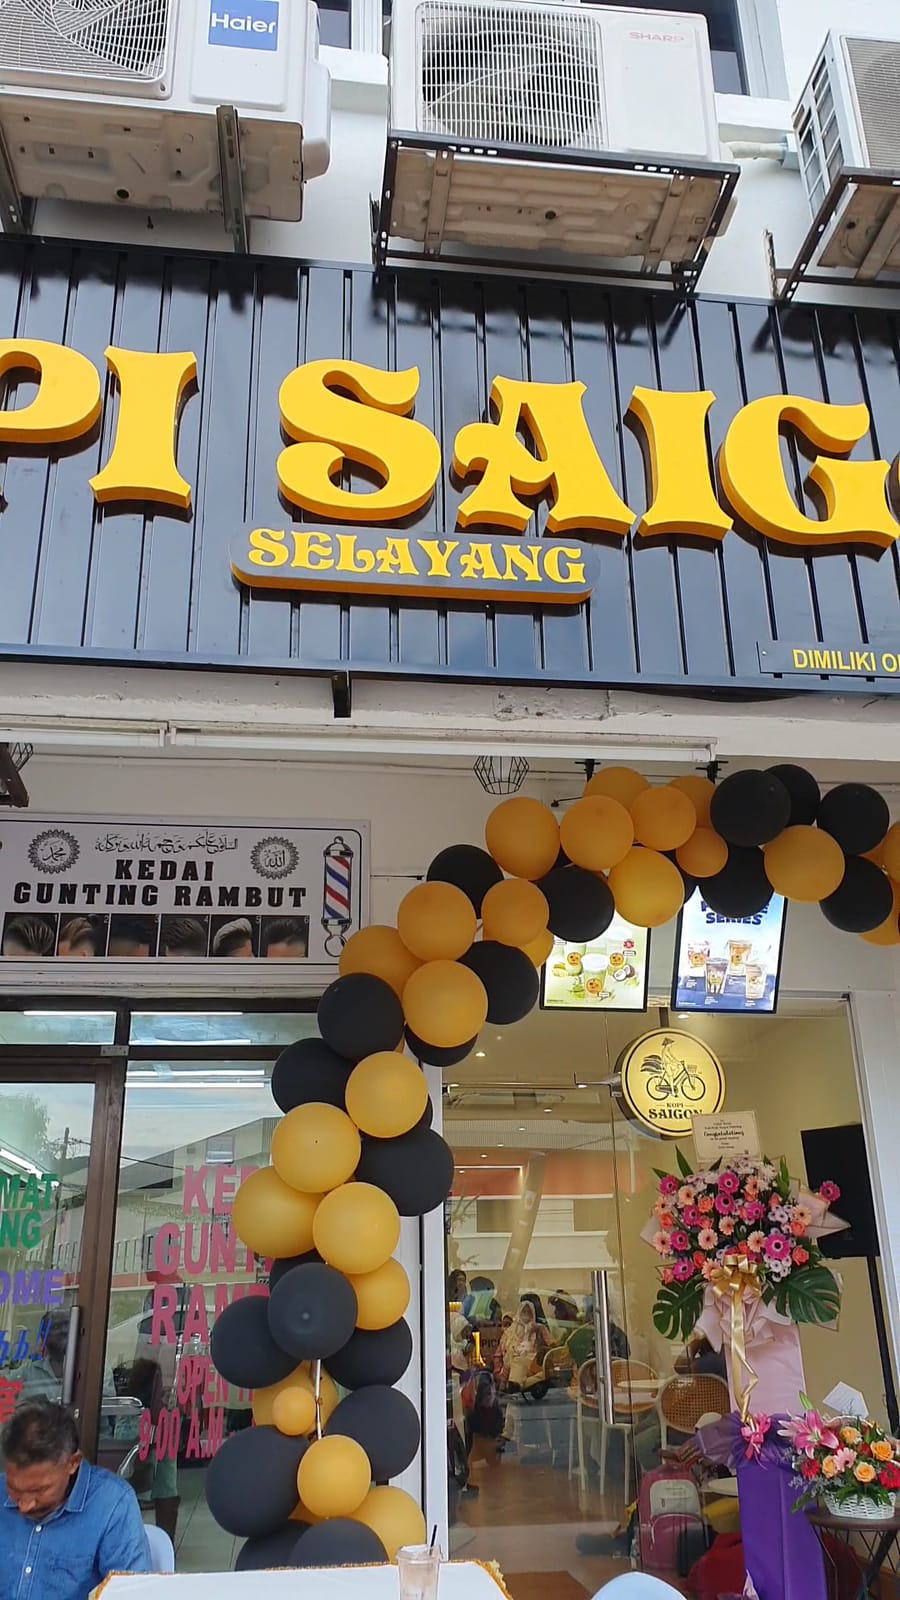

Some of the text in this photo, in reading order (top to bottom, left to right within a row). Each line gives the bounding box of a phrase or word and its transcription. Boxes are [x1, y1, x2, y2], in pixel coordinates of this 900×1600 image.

[211, 12, 276, 34] Haier
[277, 358, 900, 549] SAIG
[248, 527, 586, 584] SELAYANG
[792, 648, 900, 673] DIMILIKI O
[115, 859, 214, 881] KEDAI
[14, 881, 307, 908] GUNTING RAMBUT
[183, 1165, 259, 1216] KE
[154, 1222, 273, 1276] GUN
